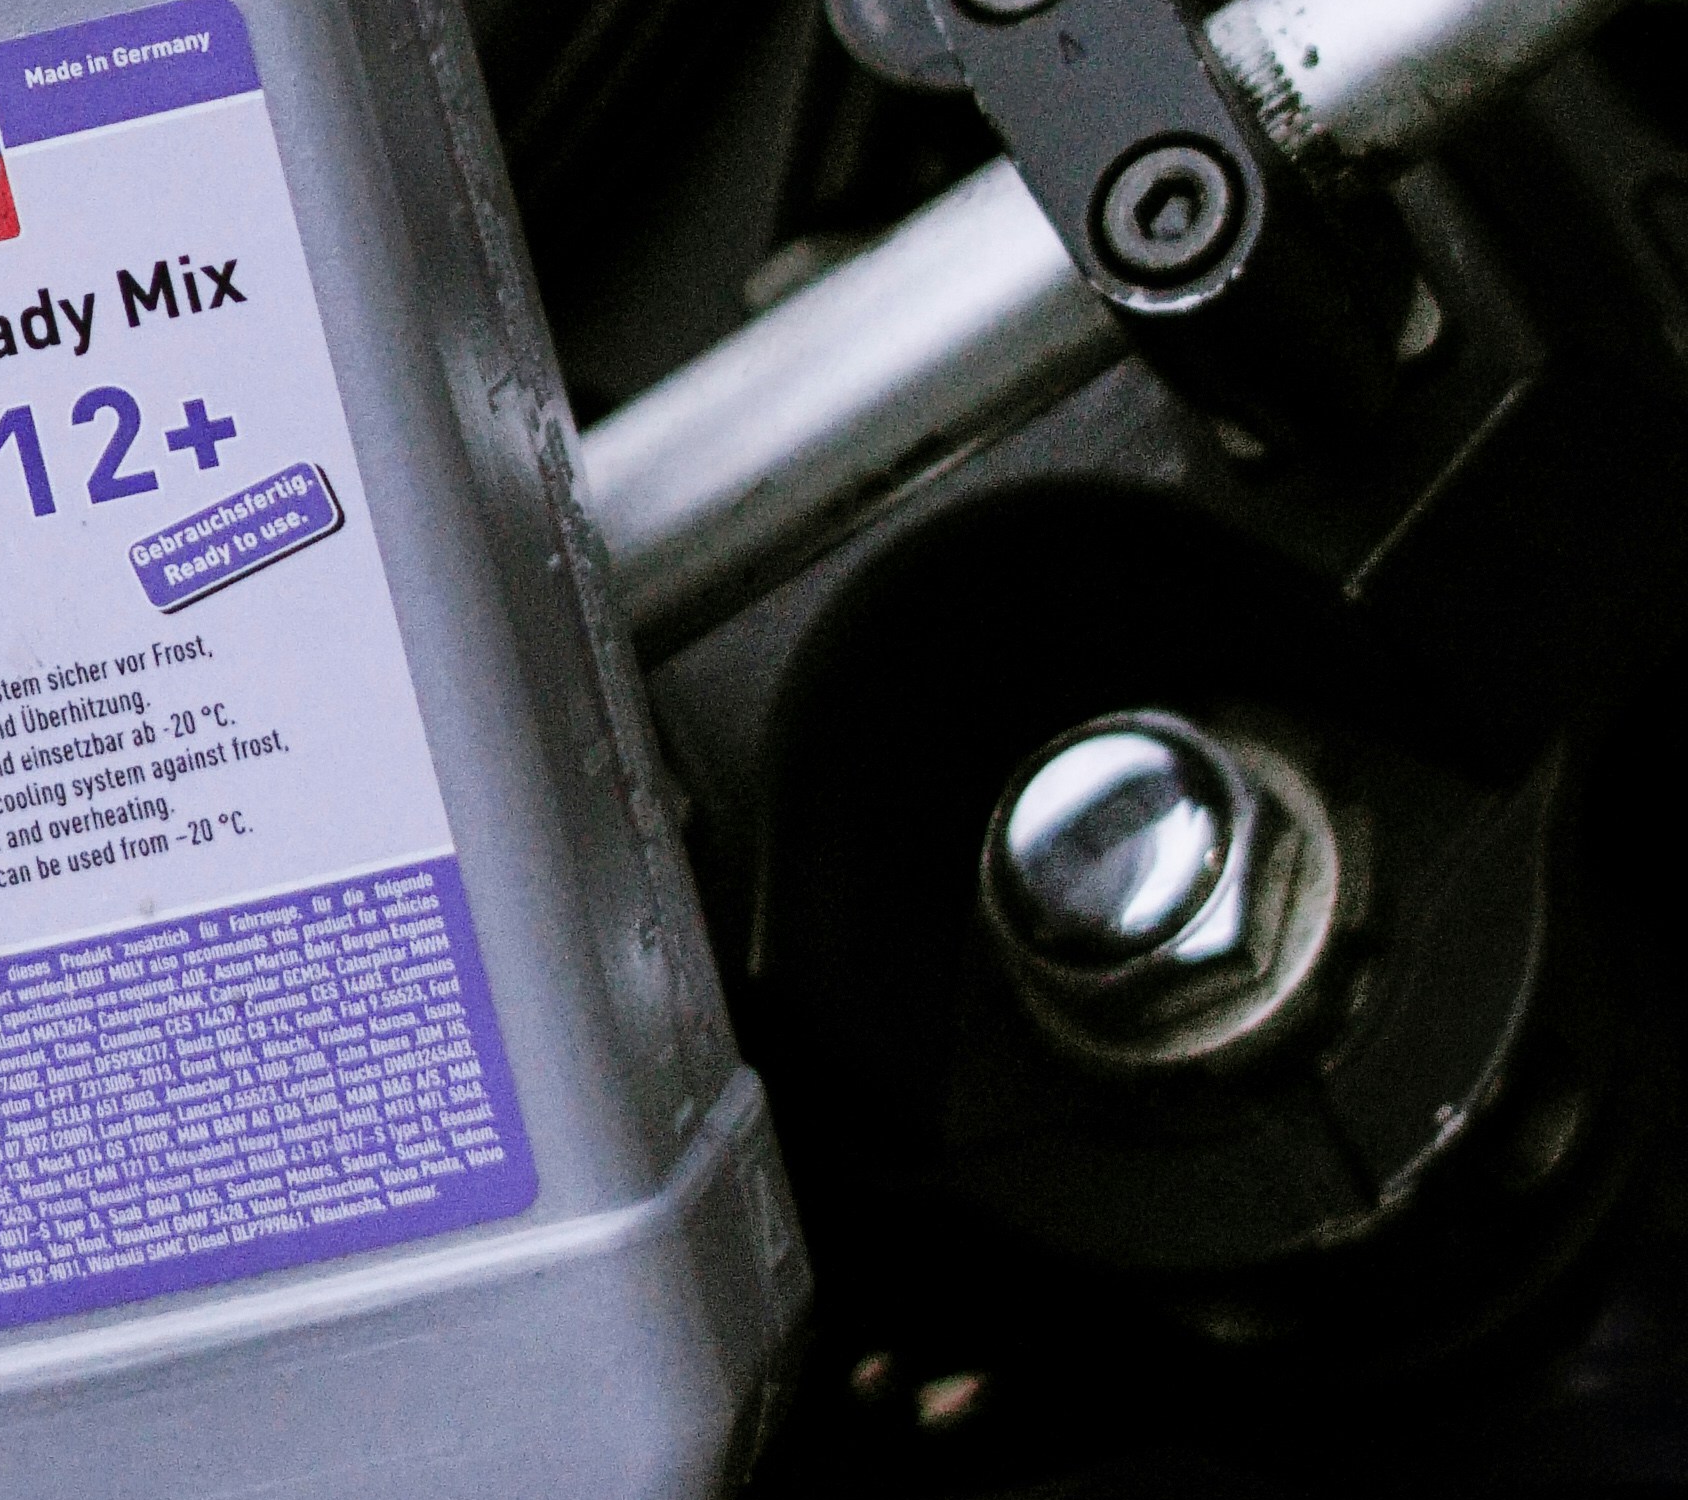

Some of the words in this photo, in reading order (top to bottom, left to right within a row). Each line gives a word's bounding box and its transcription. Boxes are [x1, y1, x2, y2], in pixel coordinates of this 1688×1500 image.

[23, 59, 83, 88] Made
[85, 54, 109, 74] in
[111, 31, 209, 67] Germany
[115, 254, 247, 328] Mix
[129, 472, 313, 567] Gebrauchsfertig.
[162, 543, 230, 586] Ready
[232, 531, 258, 553] to
[258, 509, 309, 539] use.
[46, 660, 107, 691] sicher
[113, 651, 145, 676] vor
[151, 634, 213, 667] Frost,
[20, 690, 150, 734] Überhitzung.
[20, 731, 123, 771] einsetzbar
[131, 720, 156, 747] ab
[71, 764, 146, 800] system
[150, 742, 227, 782] against
[231, 729, 289, 761] frost,
[5, 819, 43, 849] and
[48, 796, 174, 839] overheating.
[35, 855, 61, 880] be
[66, 840, 116, 872] used
[119, 833, 169, 860] from
[6, 960, 50, 982] dieses
[58, 943, 114, 970] Produkt
[310, 894, 332, 913] für
[341, 887, 365, 906] die
[107, 958, 146, 982] MOLY
[148, 953, 179, 973] also
[182, 932, 267, 965] recommends
[270, 924, 298, 945] this
[301, 910, 355, 941] product
[357, 907, 378, 925] for
[381, 893, 439, 919] vehicles
[2, 994, 94, 1029] specifications
[95, 989, 118, 1007] are
[212, 959, 253, 981] Aston
[389, 915, 445, 940] Engines
[98, 1023, 162, 1049] Cummins
[163, 1013, 192, 1035] CES
[243, 990, 308, 1017] Cummins
[310, 980, 338, 1002] CES
[390, 957, 455, 984] Cummins
[208, 973, 281, 1003] Caterpillar
[334, 944, 408, 974] Caterpillar
[338, 995, 367, 1017] Fiat
[428, 974, 460, 996] Ford
[178, 1052, 217, 1076] Great
[2, 1114, 48, 1137] Jaguar
[98, 1115, 132, 1138] Land
[176, 1097, 222, 1121] Lancia
[281, 1070, 335, 1098] Leyland
[337, 1060, 382, 1085] Trucks
[176, 1120, 210, 1143] MAN
[344, 1081, 378, 1105] MAN
[447, 1058, 481, 1081] MAN
[18, 1176, 62, 1199] Mazda
[236, 1130, 279, 1152] Heavy
[280, 1116, 338, 1142] Industry
[47, 1240, 74, 1258] Van
[247, 1194, 287, 1215] Volvo
[379, 1164, 419, 1186] Volvo
[465, 1145, 504, 1166] Volvo
[54, 1216, 86, 1237] Type
[107, 1200, 142, 1223] Saab
[225, 1173, 281, 1198] Santana
[186, 1225, 229, 1250] Diesel
